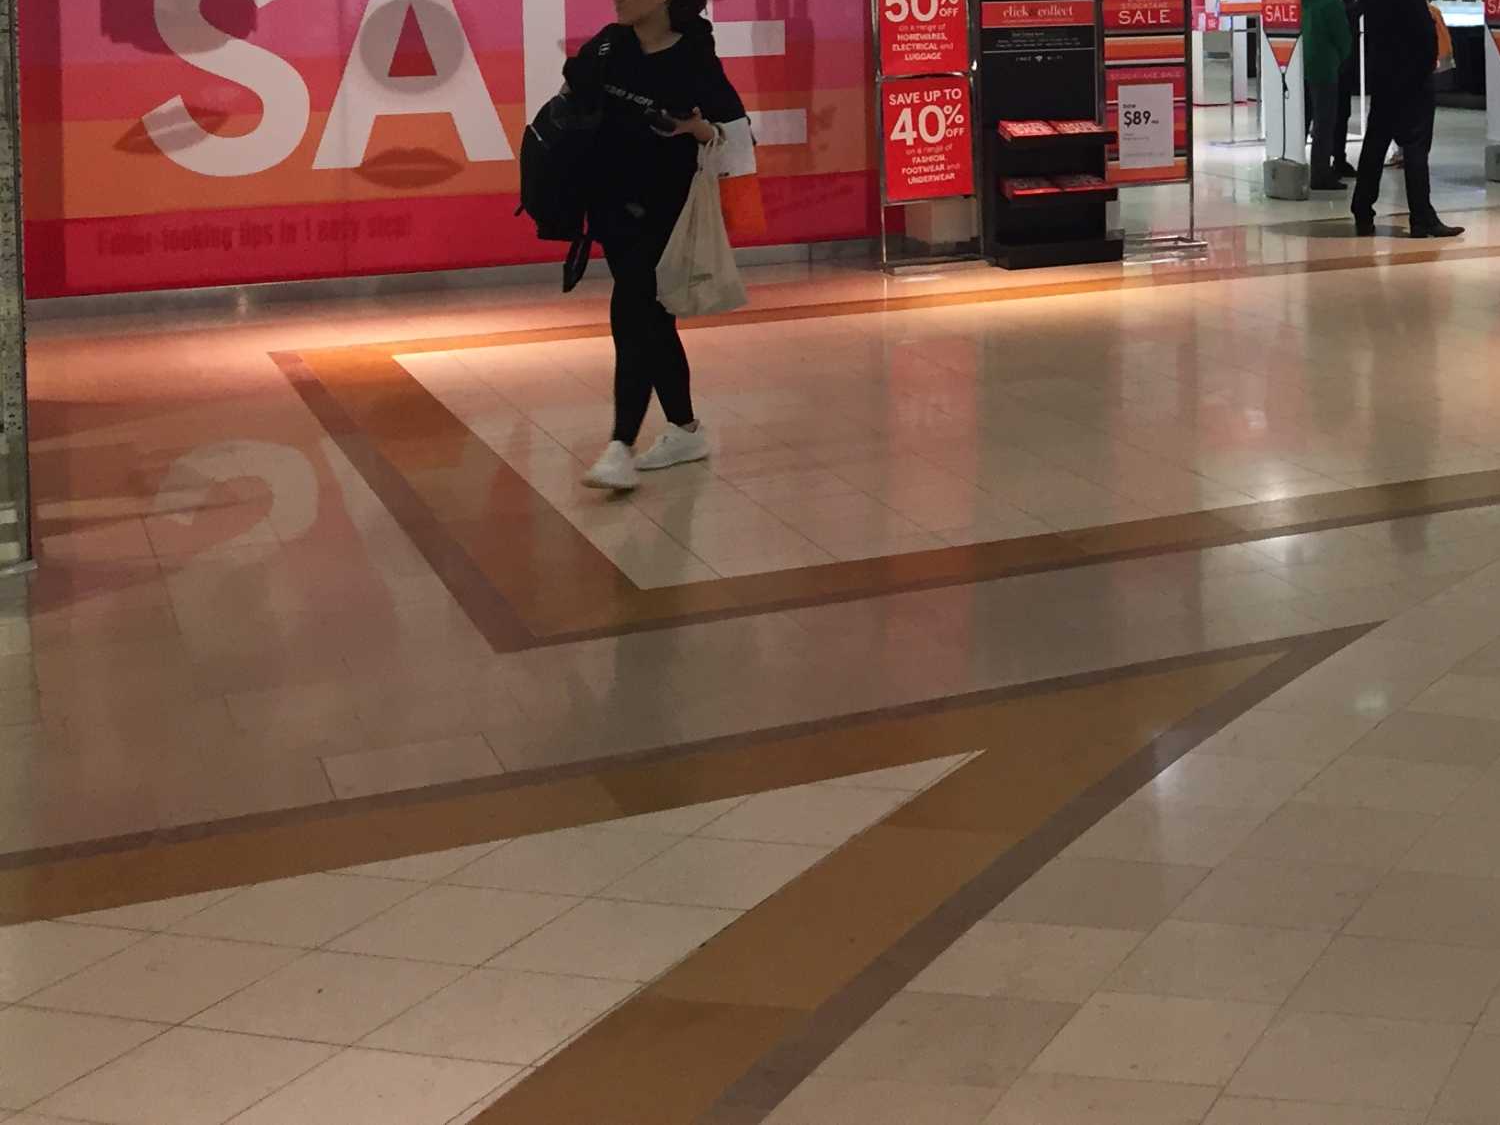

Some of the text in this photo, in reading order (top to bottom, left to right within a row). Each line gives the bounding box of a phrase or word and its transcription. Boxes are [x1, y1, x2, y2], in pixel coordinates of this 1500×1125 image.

[939, 7, 959, 17] OFF
[1118, 9, 1171, 25] SALE
[1265, 5, 1298, 22] SALE
[904, 52, 942, 61] LUGGAGE
[889, 88, 962, 106] SAVE UP TO
[890, 103, 964, 146] 40%
[1124, 110, 1151, 128] $89
[945, 127, 965, 138] OFF
